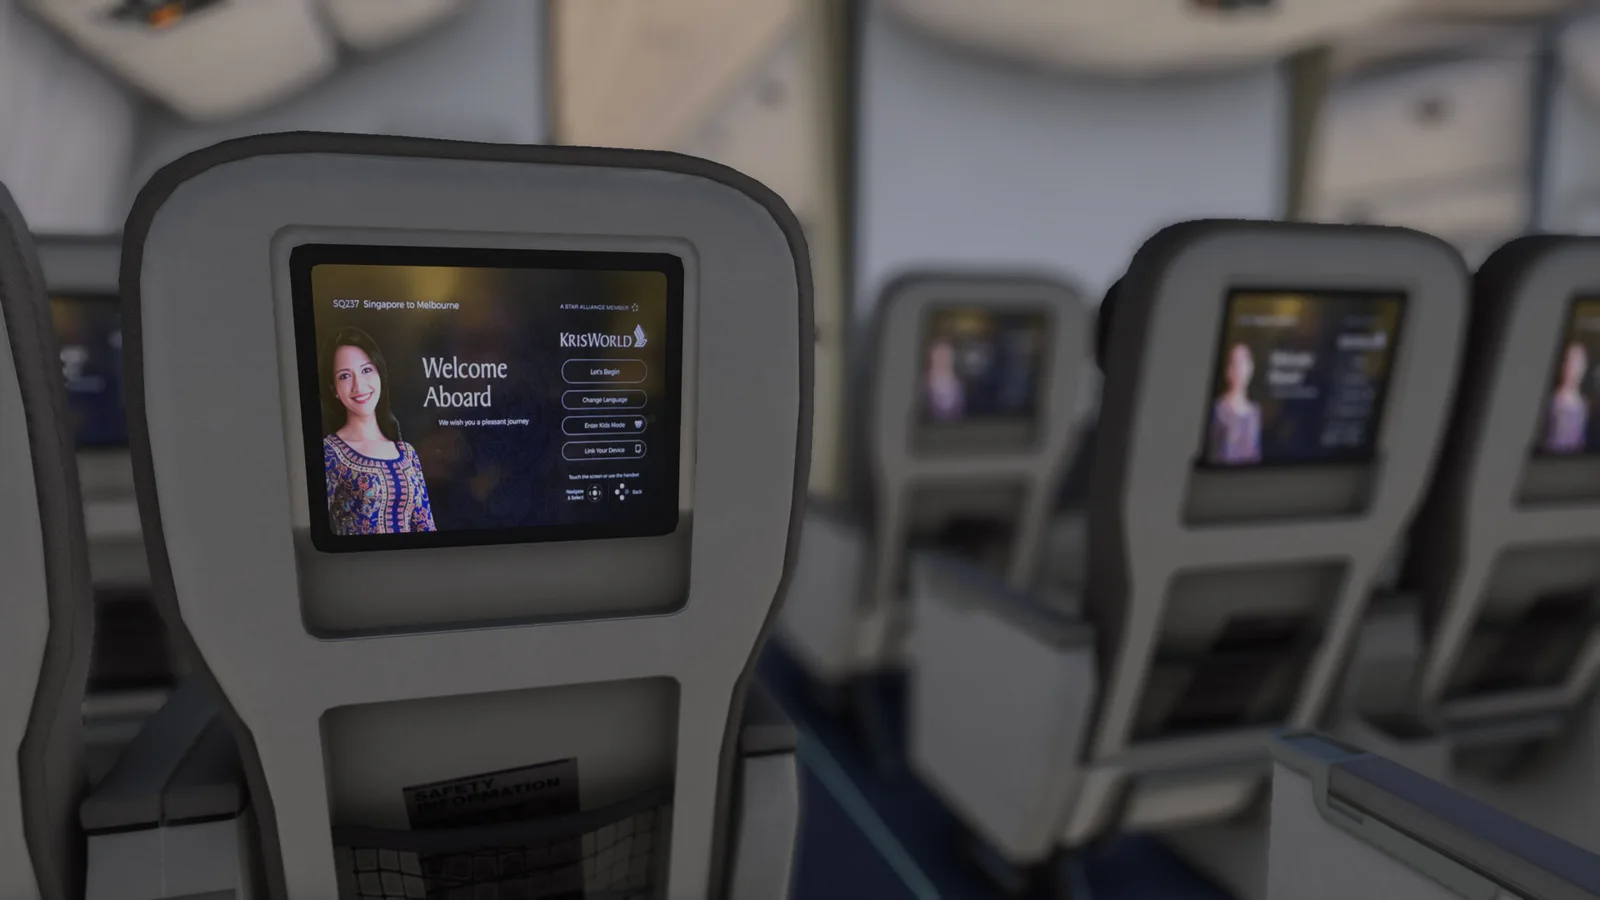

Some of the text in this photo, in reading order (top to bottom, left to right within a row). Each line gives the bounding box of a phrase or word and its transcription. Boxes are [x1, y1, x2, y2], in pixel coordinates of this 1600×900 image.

[333, 299, 460, 310] SQ237 Singapore to Melbourne
[422, 356, 508, 379] Welcome
[423, 385, 492, 407] Aboard
[482, 418, 506, 426] pleasant
[507, 418, 530, 426] journey
[414, 777, 495, 802] SAFETY
